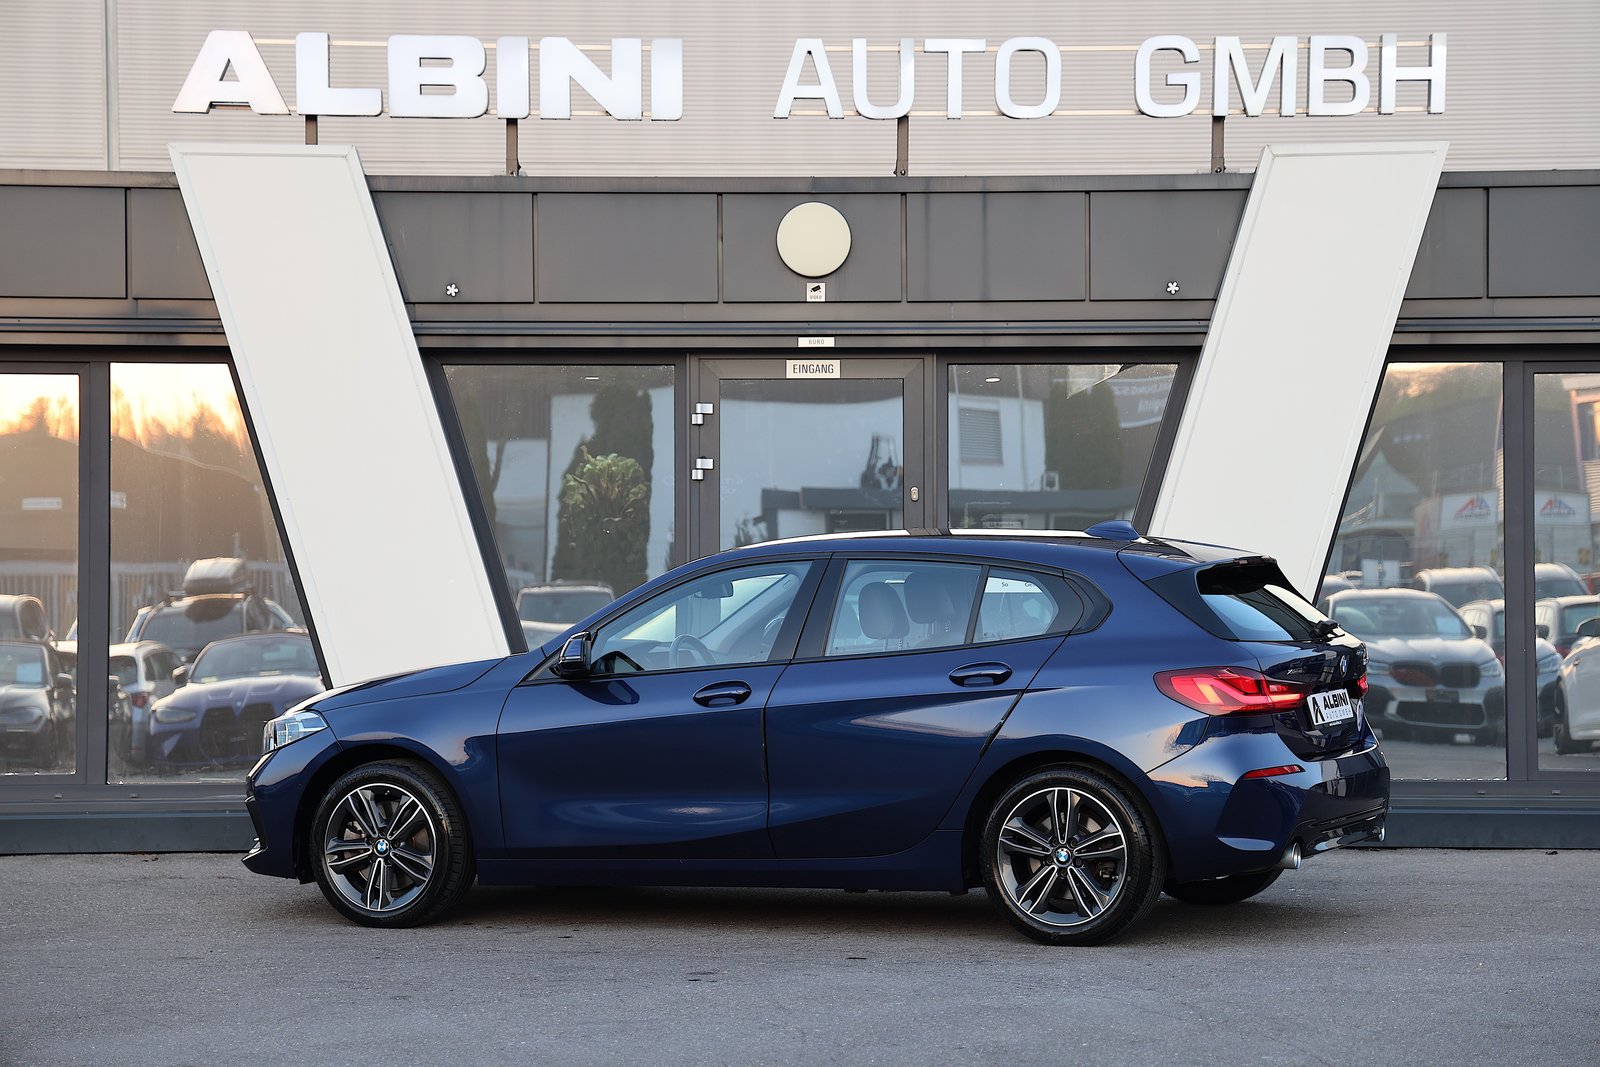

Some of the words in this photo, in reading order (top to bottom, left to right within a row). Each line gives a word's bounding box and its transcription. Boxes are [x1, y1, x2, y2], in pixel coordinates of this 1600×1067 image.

[172, 30, 684, 121] ALBINI
[773, 36, 1062, 120] AUTO
[1134, 33, 1447, 119] GMBH
[792, 363, 834, 374] EINGANG
[1323, 692, 1349, 710] ALBINI
